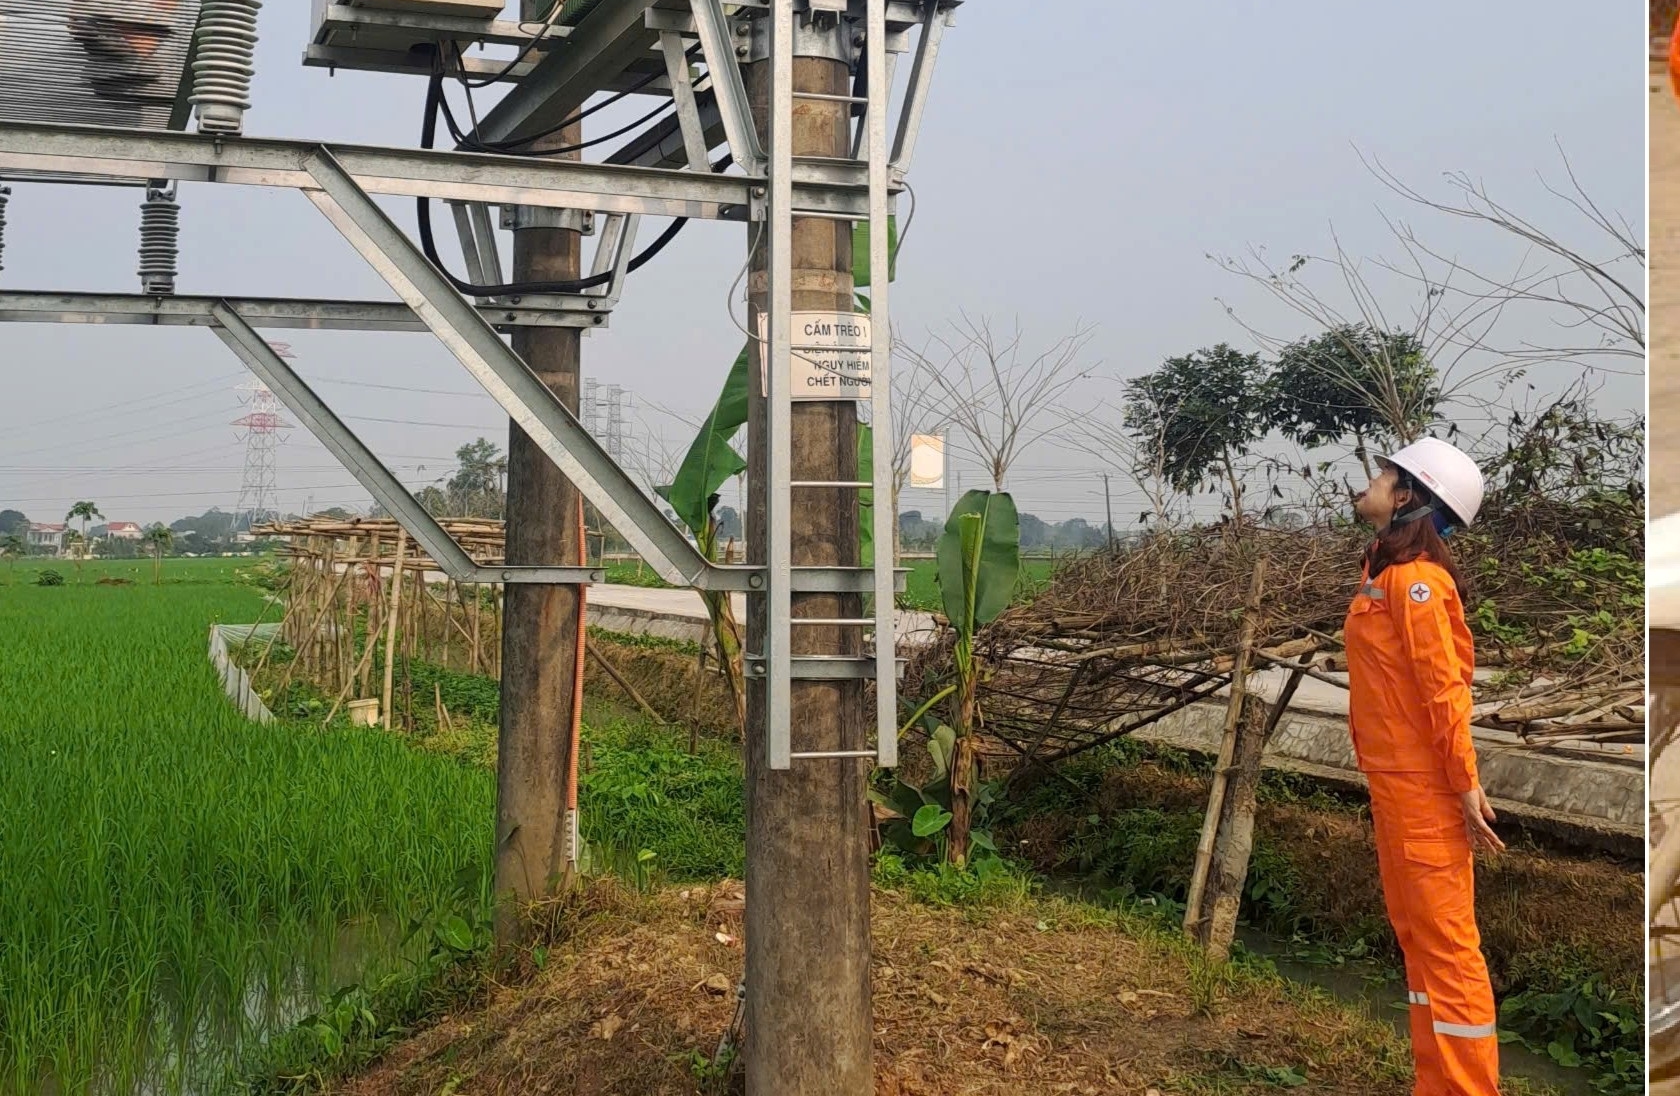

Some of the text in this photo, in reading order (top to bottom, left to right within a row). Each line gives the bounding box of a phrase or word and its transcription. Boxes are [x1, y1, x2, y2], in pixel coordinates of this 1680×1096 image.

[804, 319, 831, 336] CẤM
[833, 322, 861, 337] TRÈO
[814, 355, 870, 371] NGUY HIỂM
[807, 372, 837, 387] CHẾT
